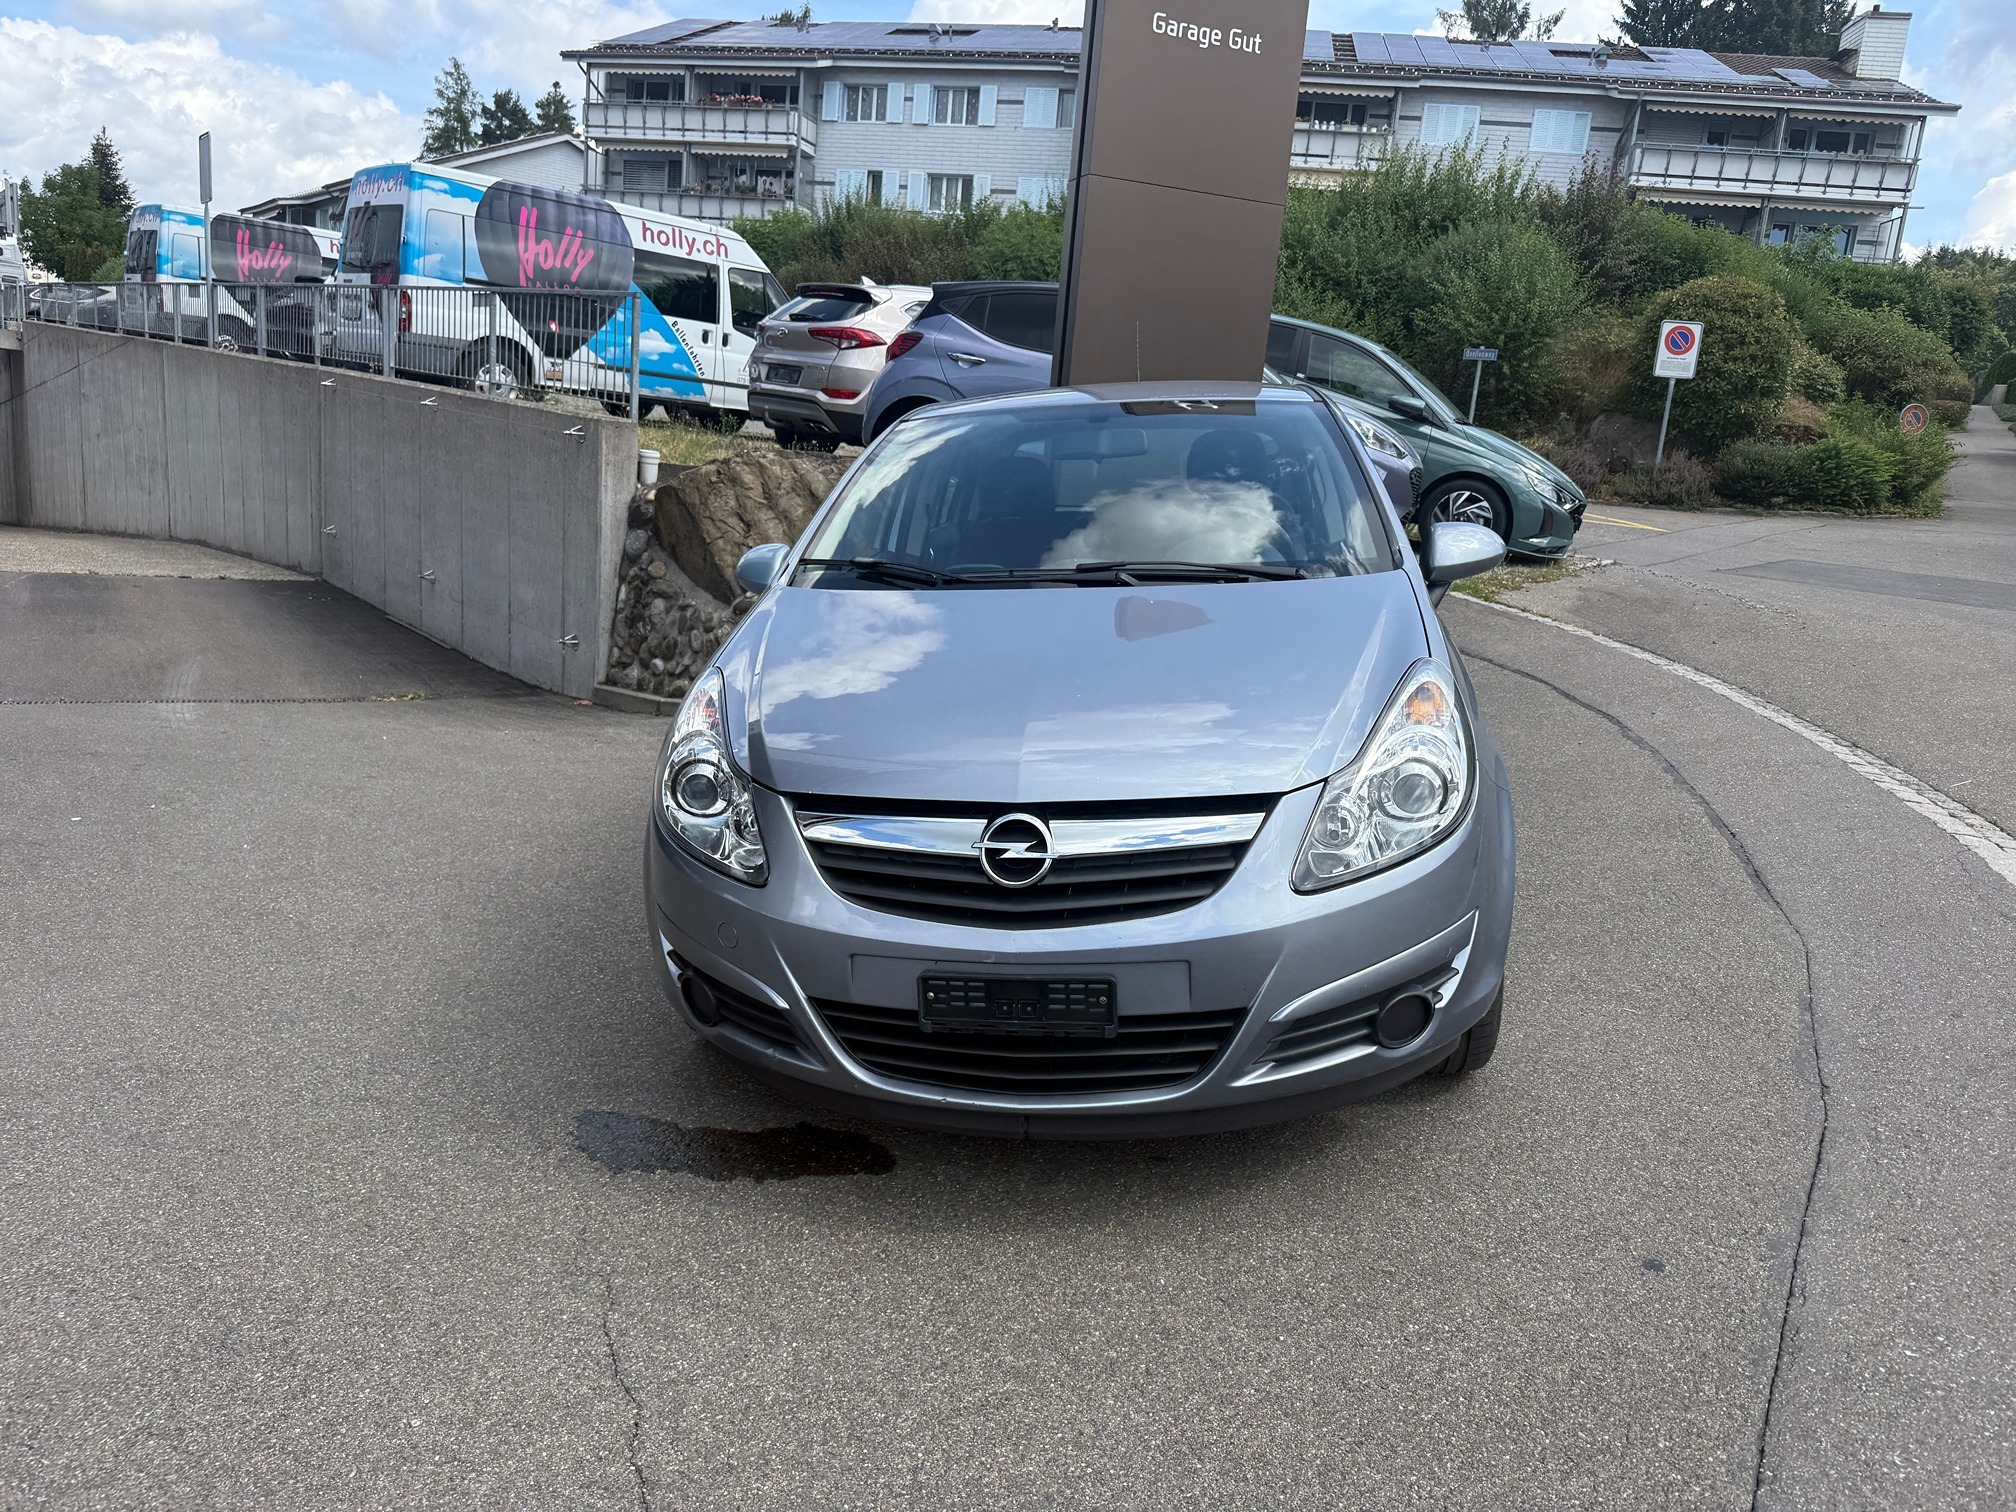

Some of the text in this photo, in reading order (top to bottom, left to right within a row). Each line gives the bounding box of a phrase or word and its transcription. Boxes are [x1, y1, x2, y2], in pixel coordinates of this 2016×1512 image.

[1152, 12, 1262, 54] Garage Gut
[354, 171, 404, 199] holly.ch
[236, 228, 293, 282] Holly
[518, 206, 595, 286] Holly
[641, 220, 729, 259] holly.ch
